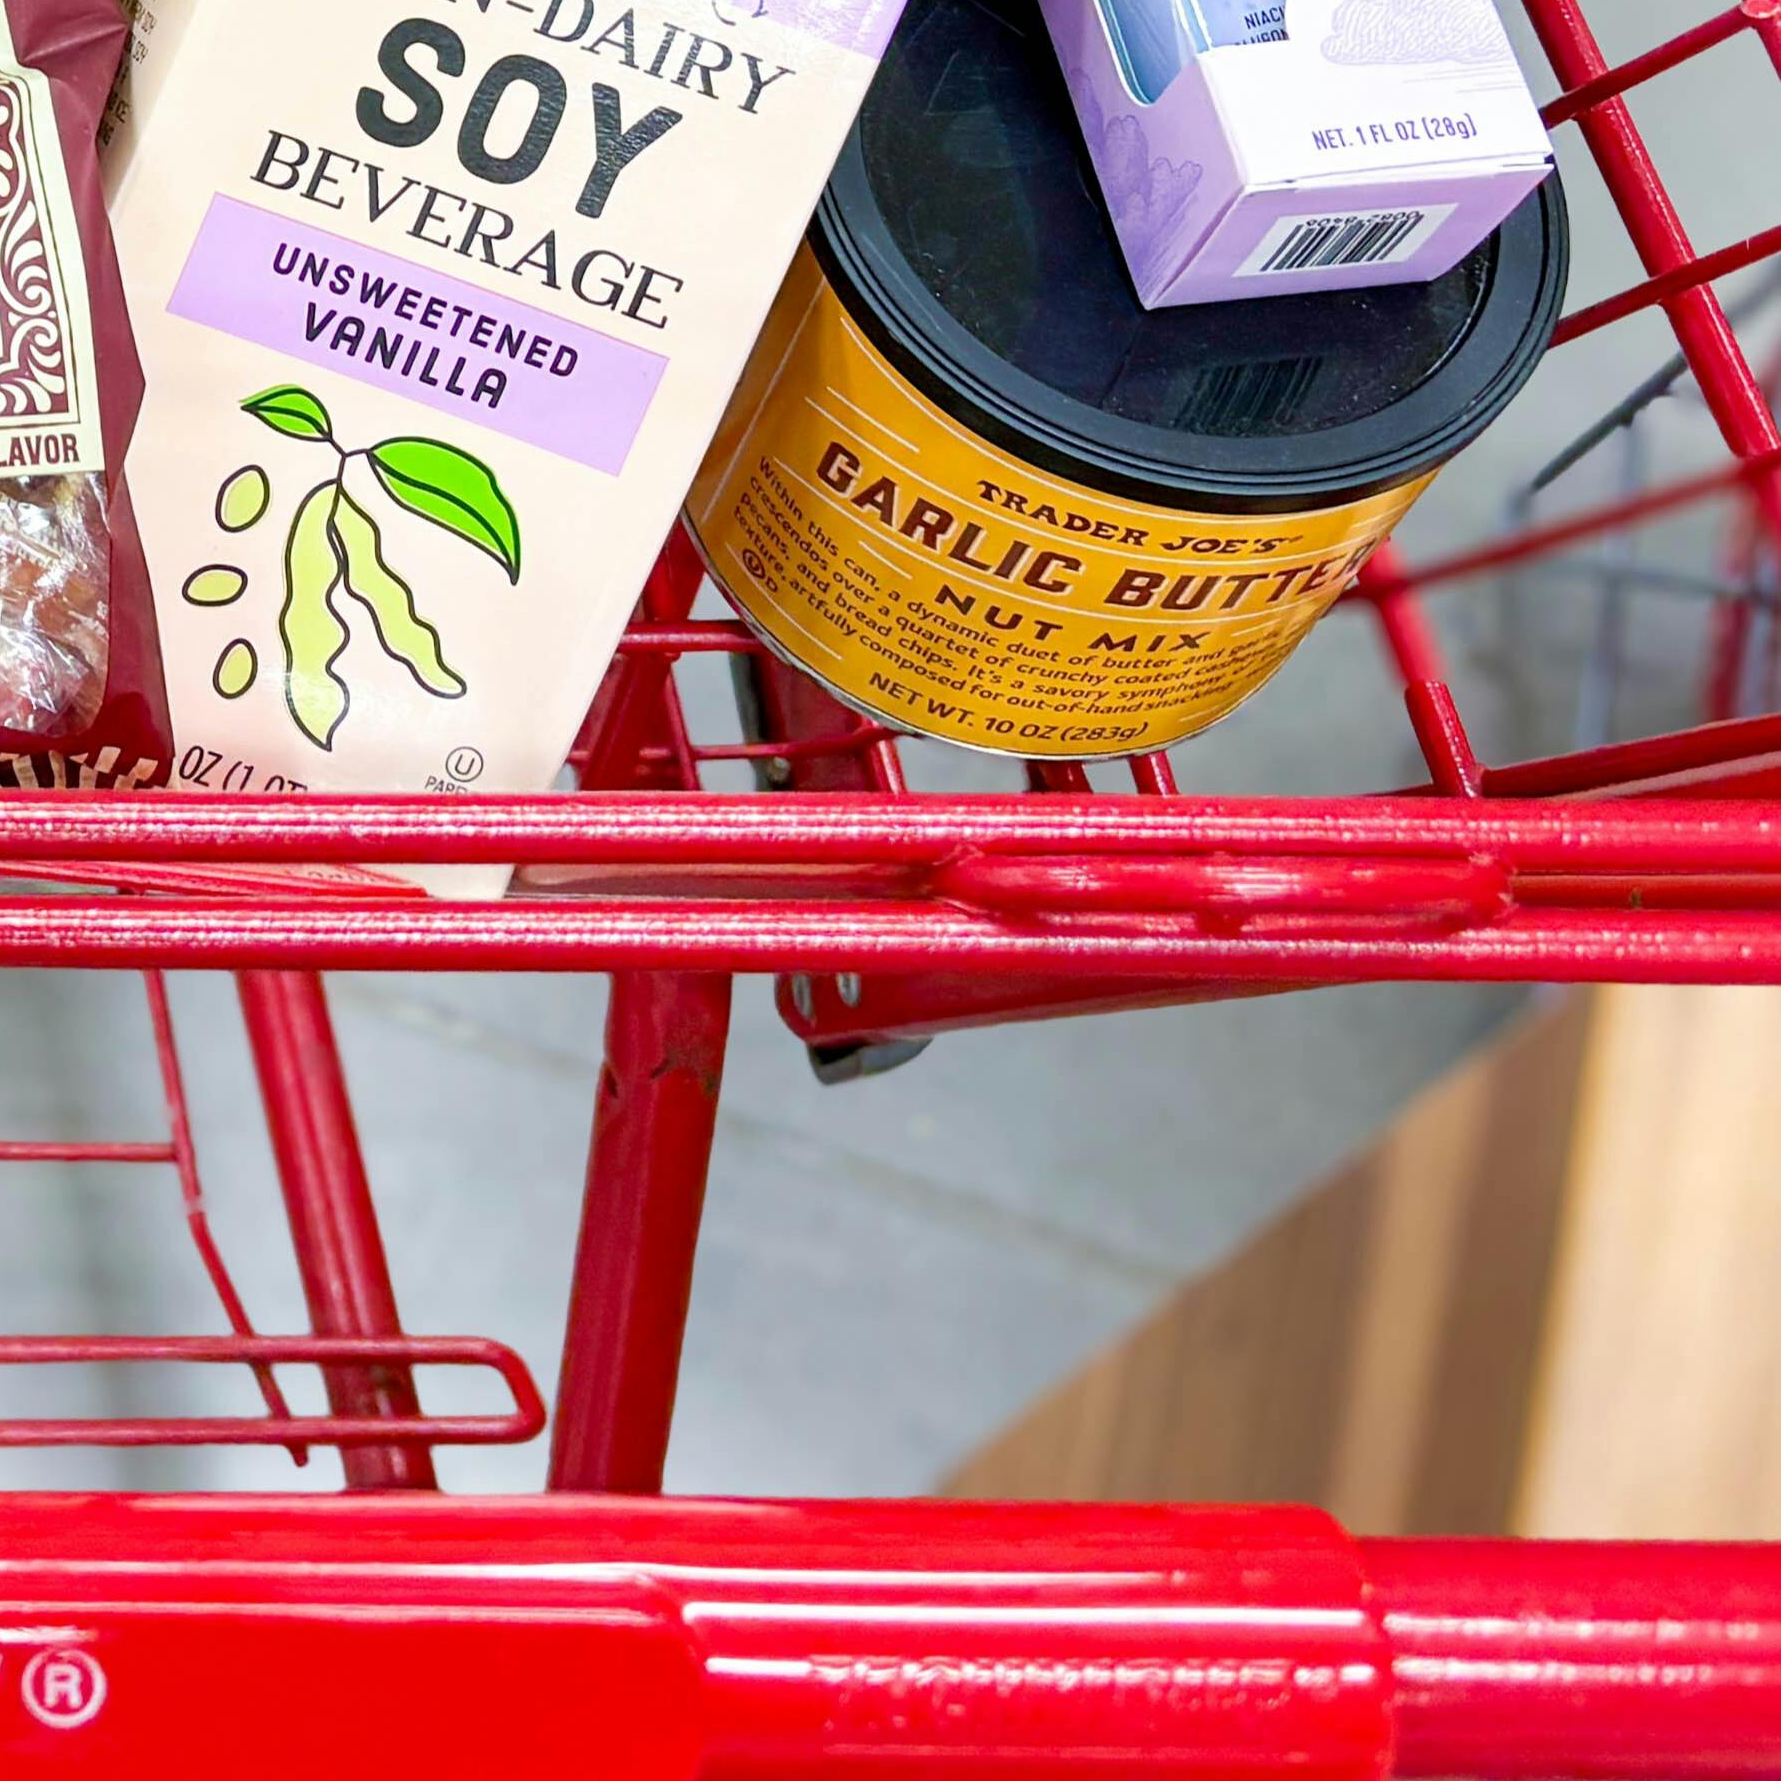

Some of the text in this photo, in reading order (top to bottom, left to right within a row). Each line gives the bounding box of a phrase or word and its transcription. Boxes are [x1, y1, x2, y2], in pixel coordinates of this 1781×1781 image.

[354, 16, 684, 221] SOY
[1311, 112, 1478, 151] NET. 1 FL OZ (28g)
[249, 129, 686, 331] BEVERAGE
[270, 241, 582, 380] UNSWEETENED
[303, 301, 511, 410] VANILLA
[749, 475, 829, 572] crescendos
[832, 571, 875, 606] over
[877, 604, 891, 617] a
[896, 615, 982, 661] quartet
[984, 653, 1015, 669] of
[1016, 662, 1109, 688] crunchy
[1113, 667, 1193, 686] coated
[758, 455, 804, 522] Within
[807, 520, 840, 557] this
[843, 556, 882, 592] can,
[887, 589, 902, 603] a
[906, 600, 1000, 648] dynamic
[1006, 641, 1061, 664] duet
[1067, 654, 1096, 668] of
[1101, 656, 1175, 670] butter
[815, 440, 1086, 596] GARLIC
[976, 479, 1150, 548] TRADER
[733, 504, 787, 581] texture,
[789, 577, 859, 638] artfully
[859, 634, 968, 693] composed
[969, 681, 1005, 702] for
[1005, 695, 1141, 716] out-of-hand
[740, 491, 791, 561] pecans,
[796, 562, 832, 594] and
[835, 584, 894, 638] bread
[898, 633, 958, 672] chips.
[967, 664, 1003, 685] It's
[1009, 679, 1025, 691] a
[1032, 683, 1110, 702] savory
[934, 583, 1064, 641] NUT
[1087, 631, 1212, 653] MIX
[178, 745, 224, 788] OZ
[869, 670, 1150, 743] NET WT. 10 OZ (283g)
